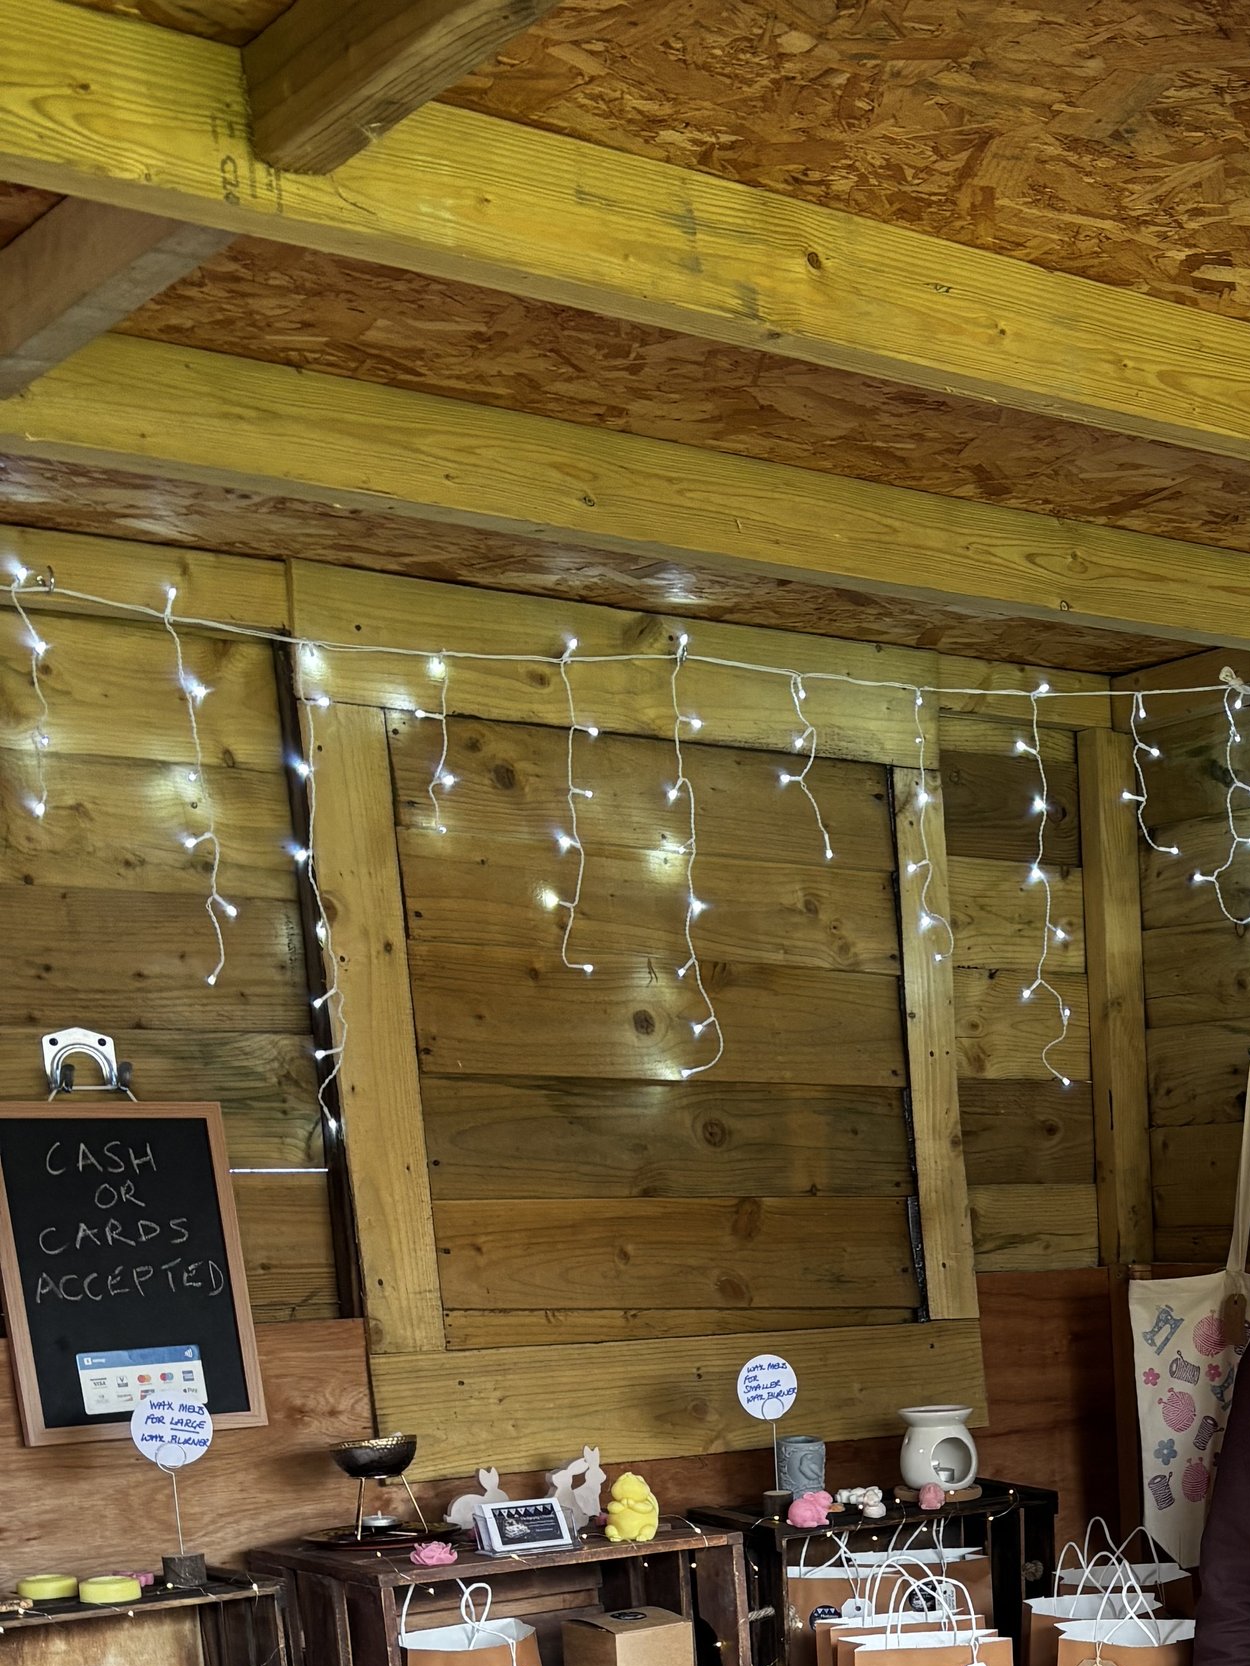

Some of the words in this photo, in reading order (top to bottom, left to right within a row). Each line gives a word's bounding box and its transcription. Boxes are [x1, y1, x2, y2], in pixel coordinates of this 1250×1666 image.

[46, 1141, 157, 1175] CASH
[94, 1179, 146, 1208] OR
[39, 1218, 189, 1255] CARDS
[35, 1258, 225, 1303] ACCEPTED
[747, 1364, 765, 1373] WAX
[743, 1375, 759, 1385] FOR
[743, 1380, 781, 1393] SMALLER
[746, 1394, 766, 1404] WAX
[767, 1387, 797, 1399] BURNER
[150, 1400, 174, 1411] WAX
[145, 1414, 165, 1425] FOR
[170, 1417, 206, 1429] LARGE
[141, 1433, 165, 1443] WAX
[170, 1434, 209, 1448] BURNER
